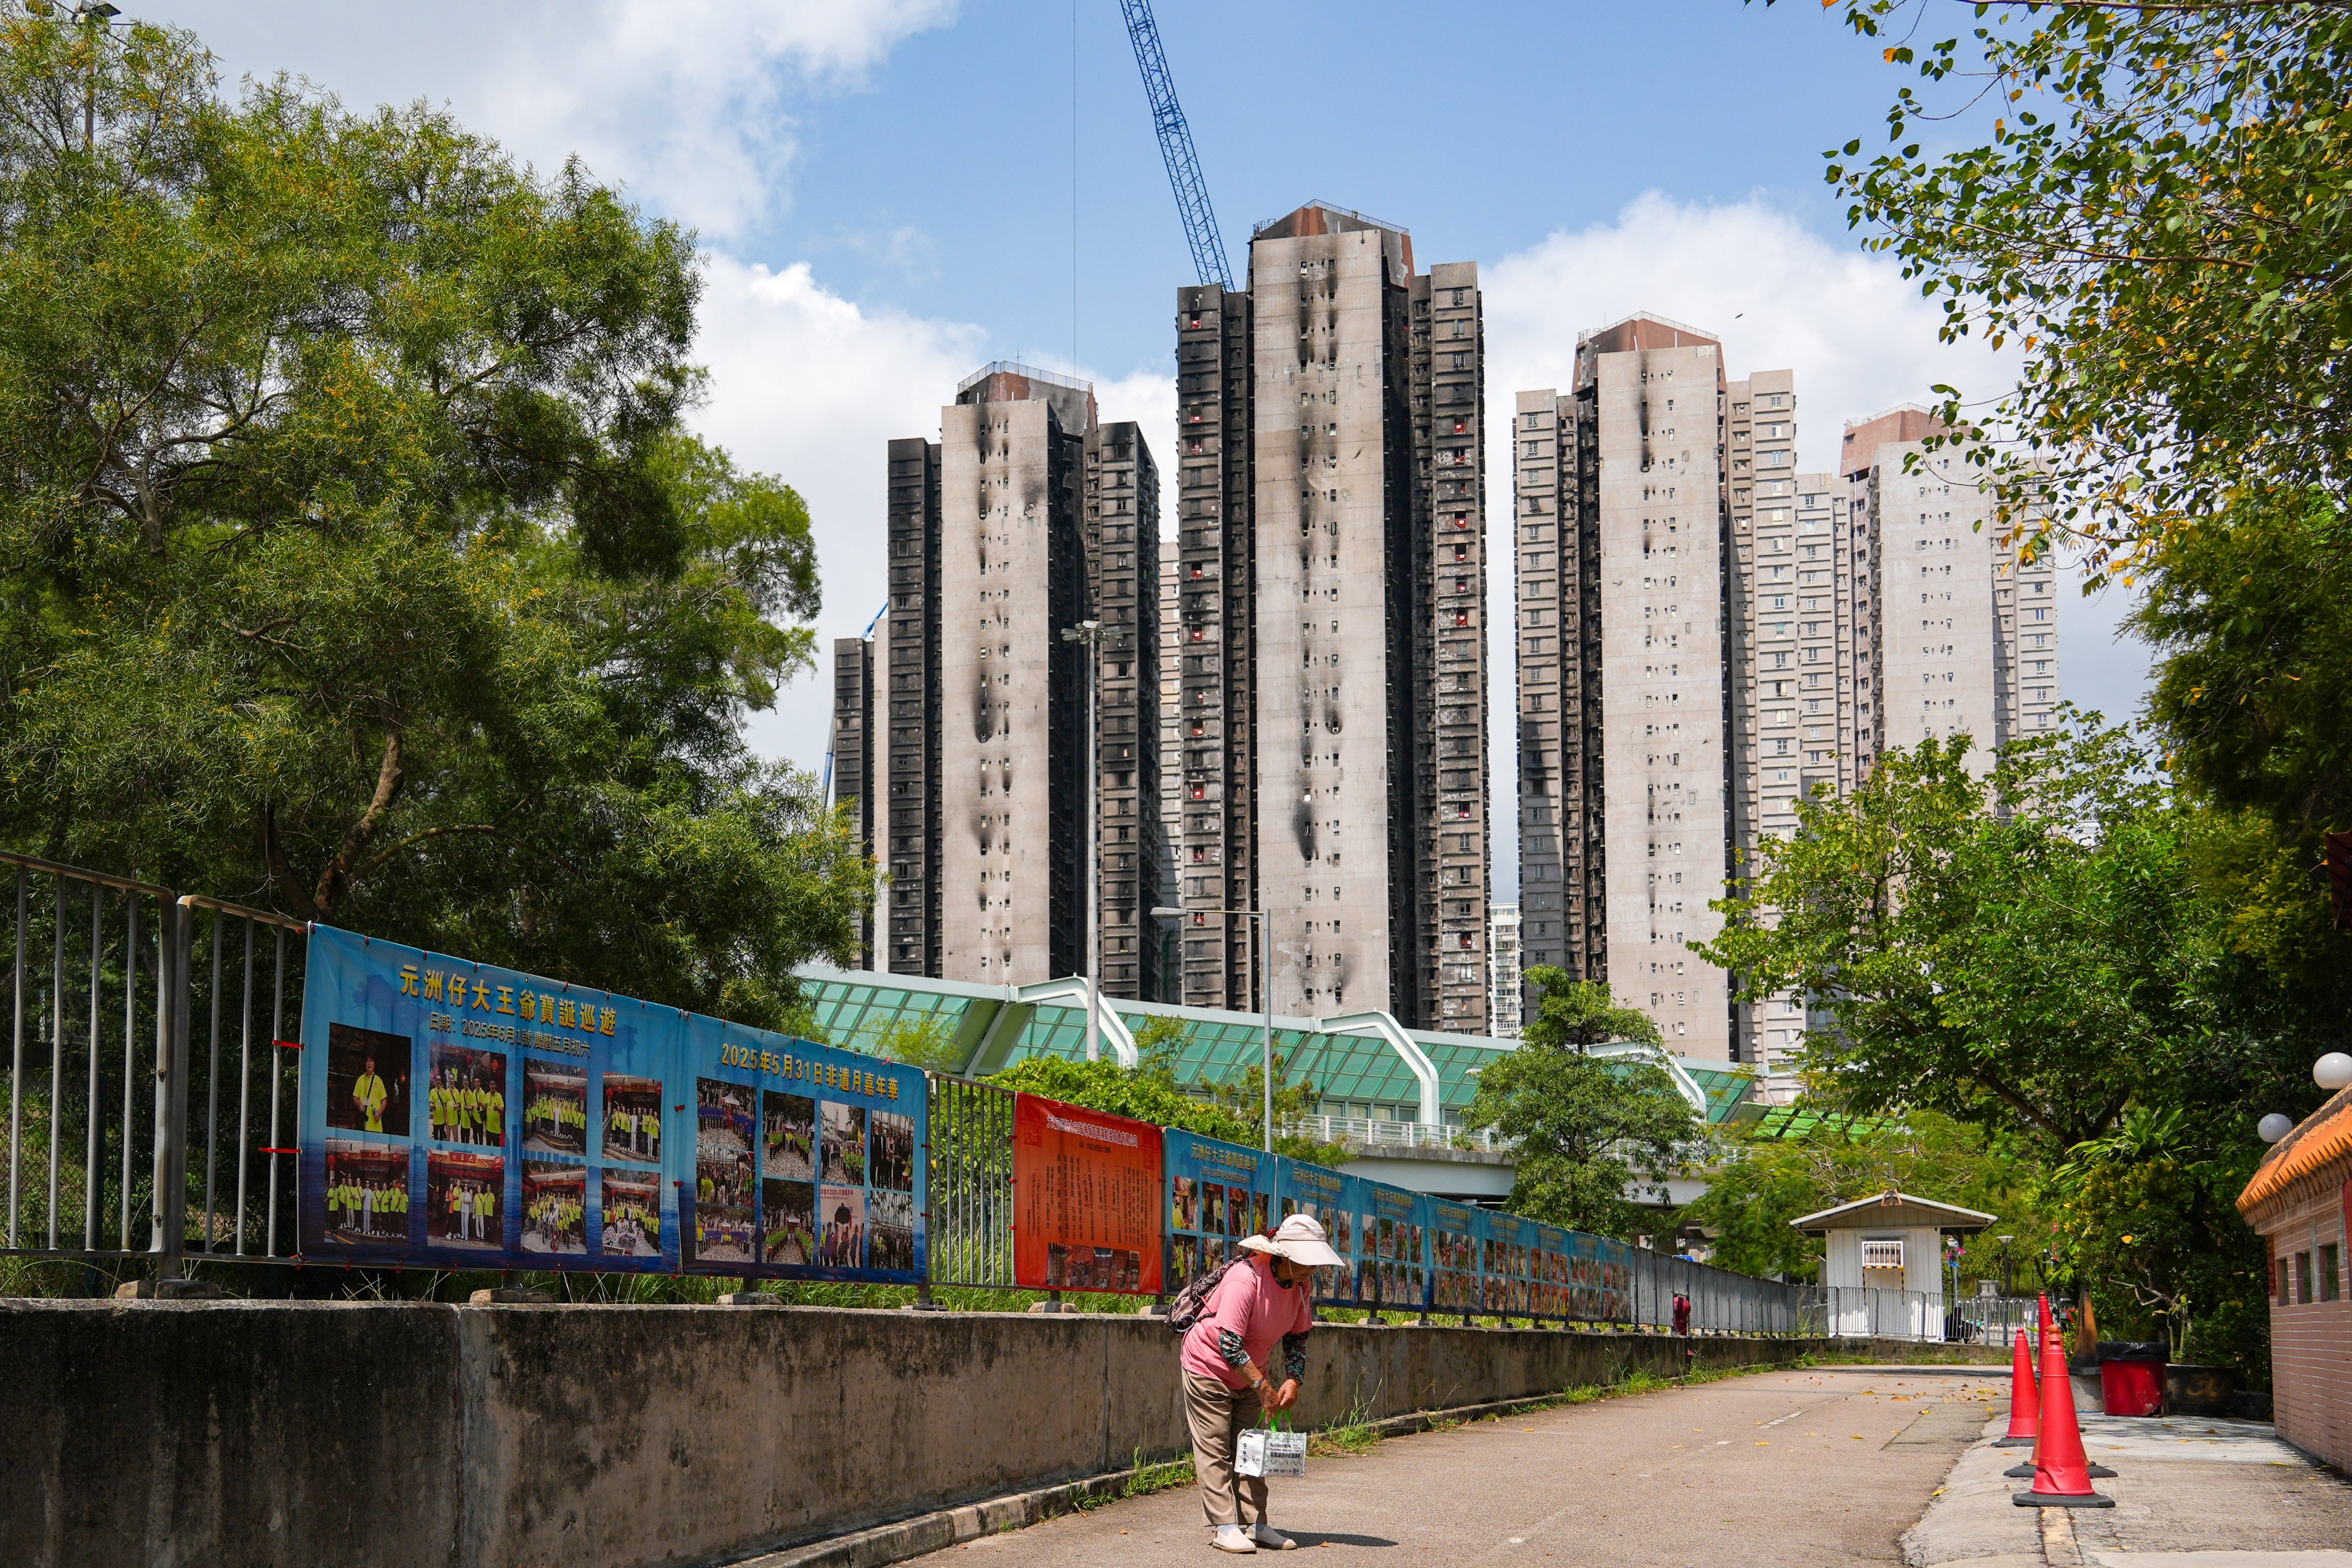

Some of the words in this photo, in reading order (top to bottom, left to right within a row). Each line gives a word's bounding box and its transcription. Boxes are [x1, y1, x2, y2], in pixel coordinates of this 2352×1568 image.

[400, 964, 616, 1037] 元洲仔大王爺寶誕巡遊
[721, 1042, 898, 1101] 2025年5月31日非遺月嘉年華
